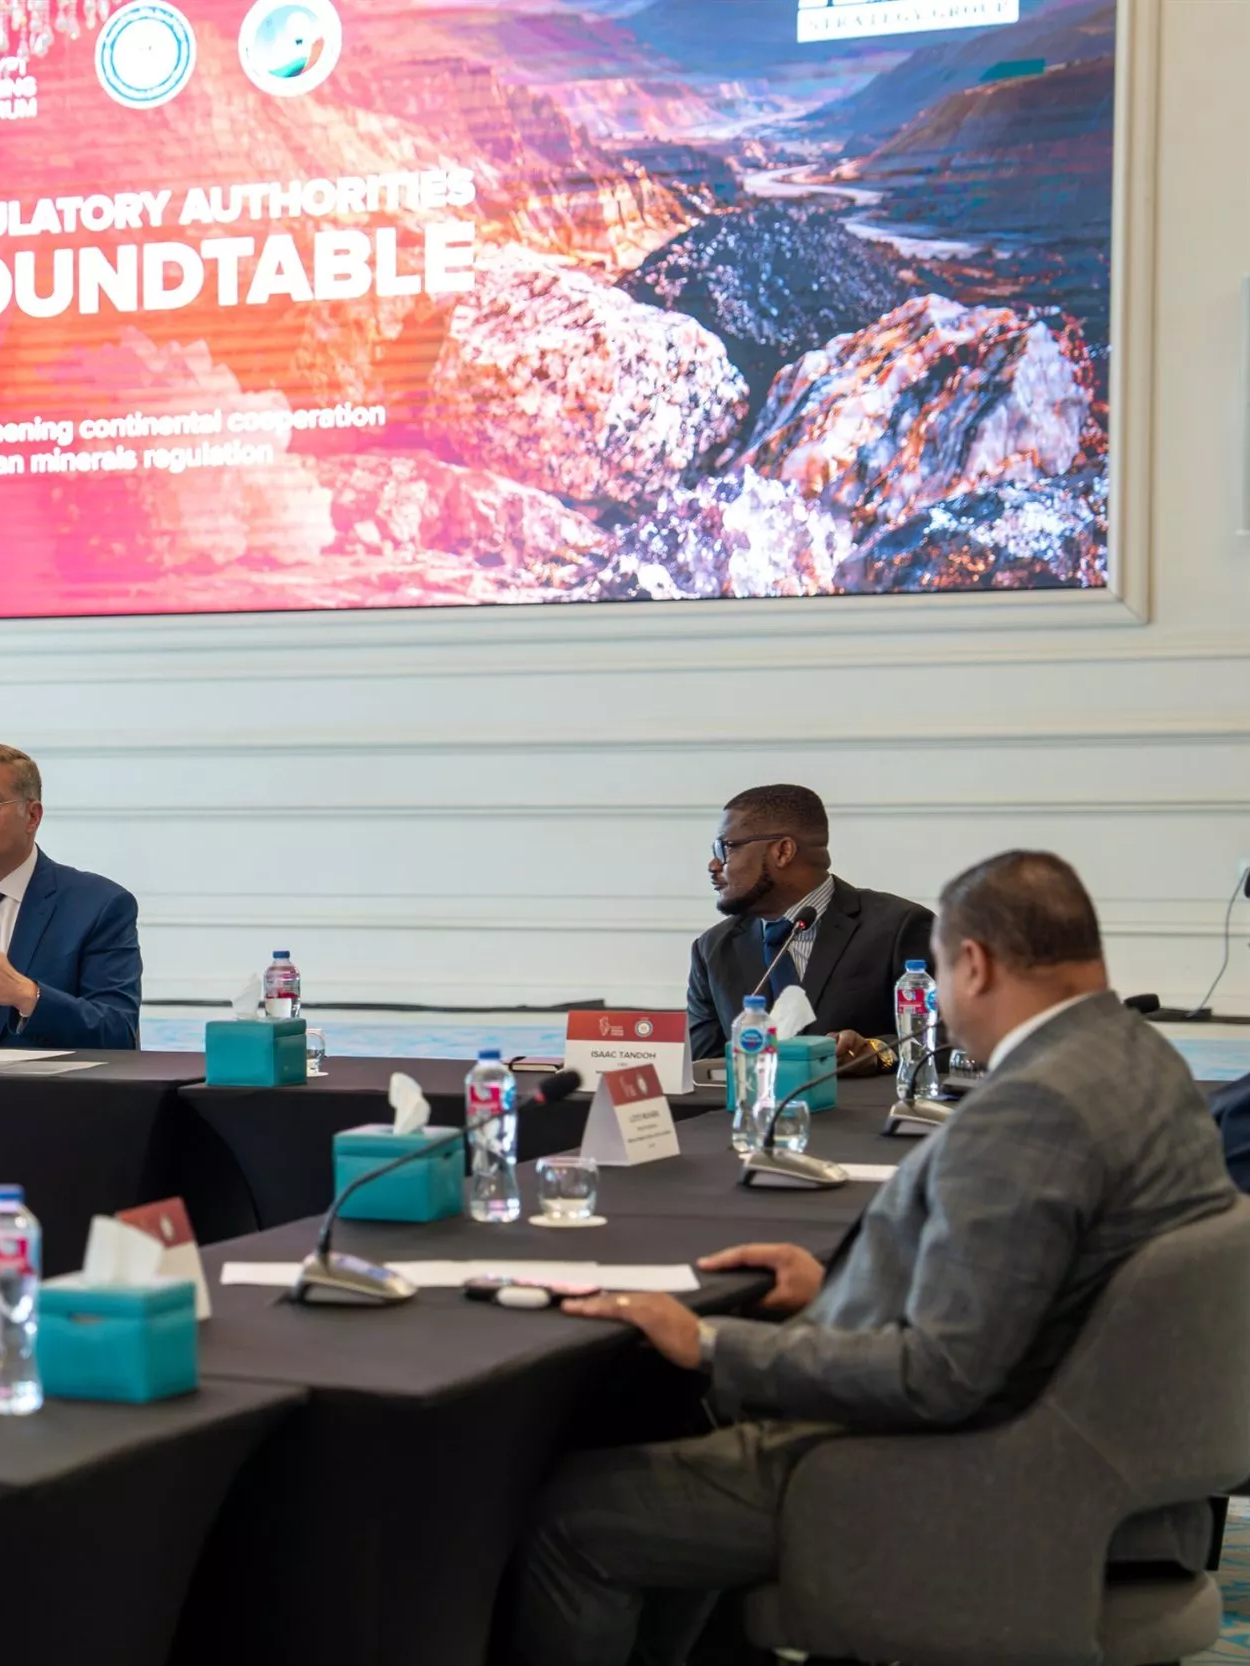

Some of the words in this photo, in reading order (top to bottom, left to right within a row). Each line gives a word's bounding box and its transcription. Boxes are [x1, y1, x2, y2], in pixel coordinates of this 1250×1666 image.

[179, 168, 476, 225] AUTHORITIES
[79, 408, 222, 439] continental
[227, 402, 386, 436] cooperation
[31, 445, 137, 473] minerals
[143, 440, 274, 473] regulation
[591, 1050, 617, 1059] ISAAC
